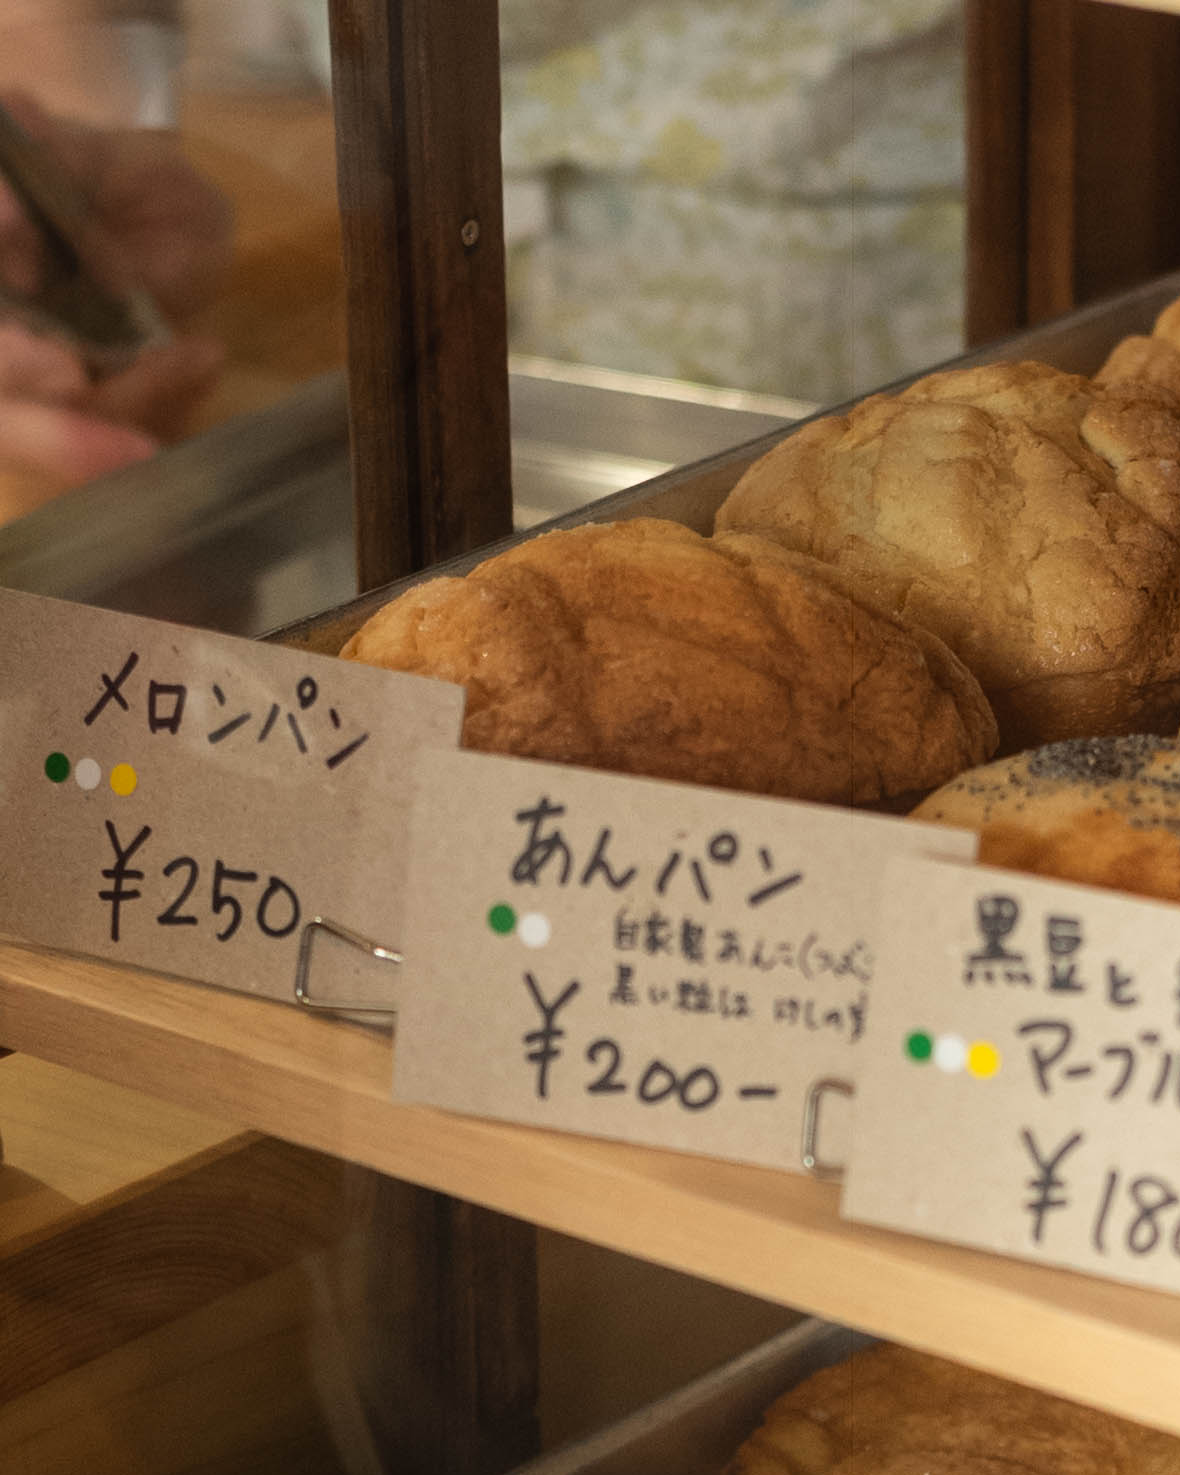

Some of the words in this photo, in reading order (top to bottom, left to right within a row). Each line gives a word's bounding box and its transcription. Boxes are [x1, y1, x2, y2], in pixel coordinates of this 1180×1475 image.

[85, 652, 370, 769] メロンパン
[98, 820, 302, 943] ¥250
[509, 798, 805, 908] あんパン
